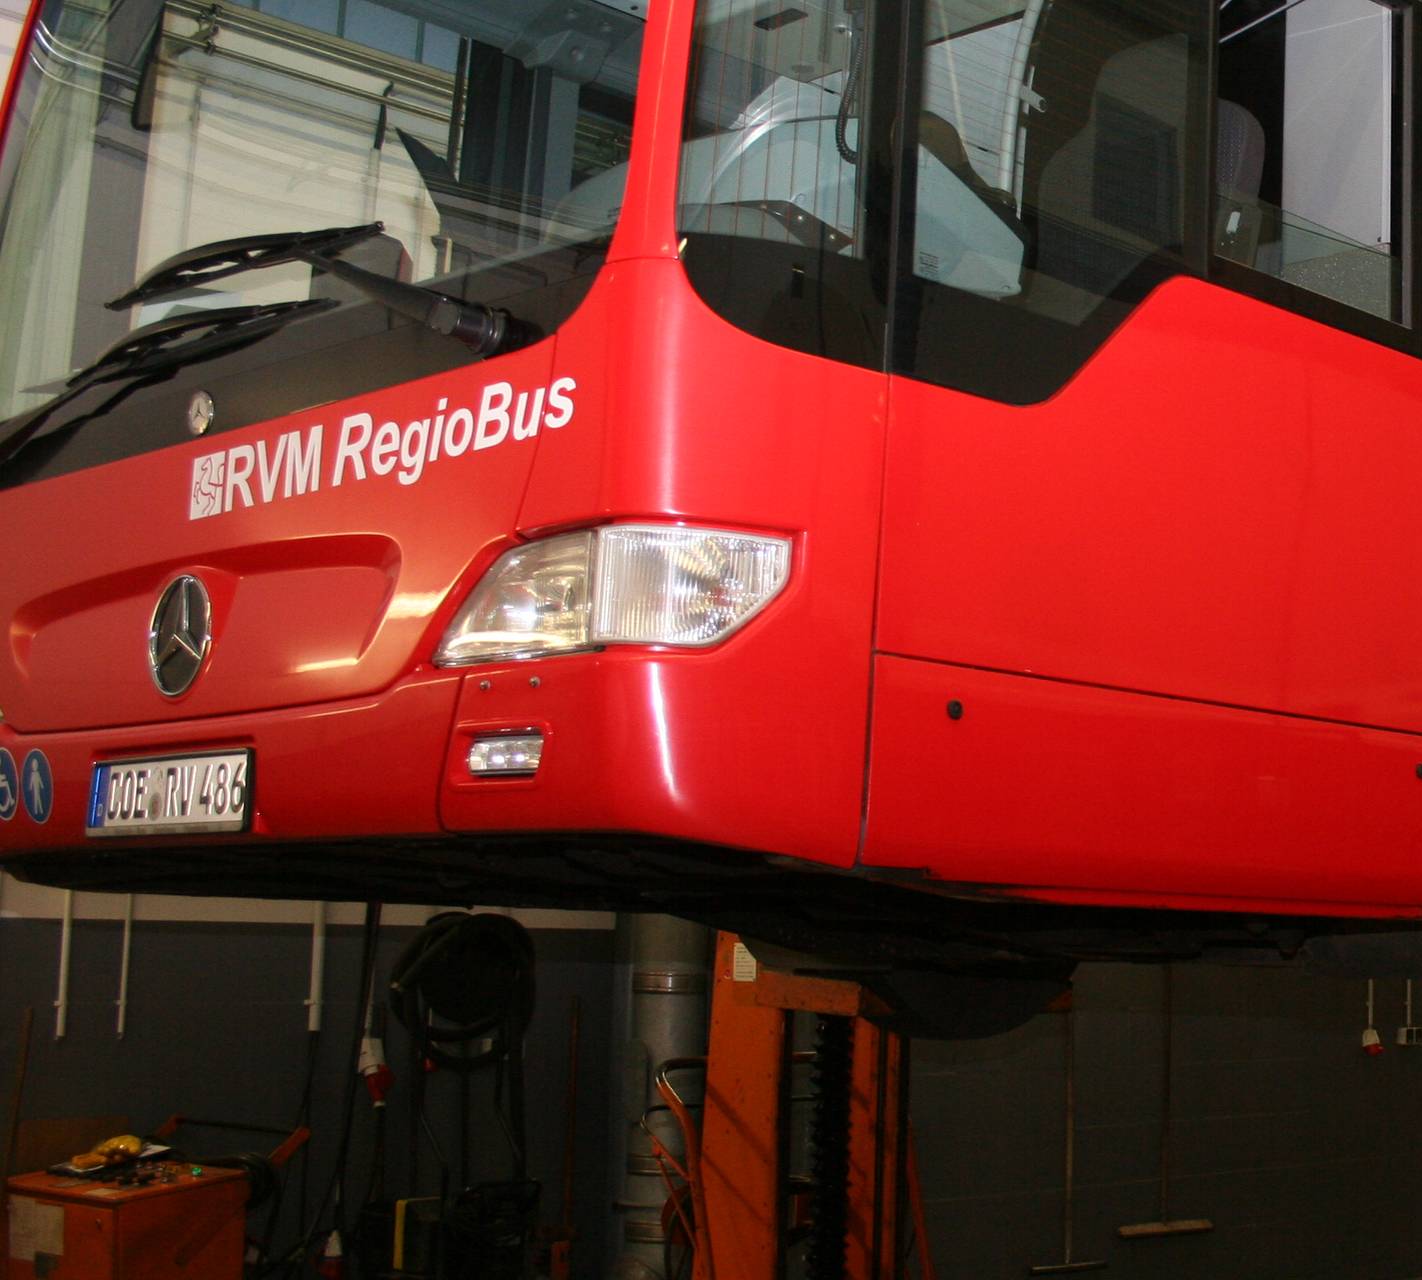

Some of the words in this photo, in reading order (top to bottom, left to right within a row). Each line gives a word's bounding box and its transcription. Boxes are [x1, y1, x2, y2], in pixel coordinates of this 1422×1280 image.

[224, 425, 323, 512] RVM
[332, 376, 577, 487] RegioBus
[107, 768, 151, 820] COE
[164, 764, 198, 818] RV
[199, 761, 247, 816] 486
